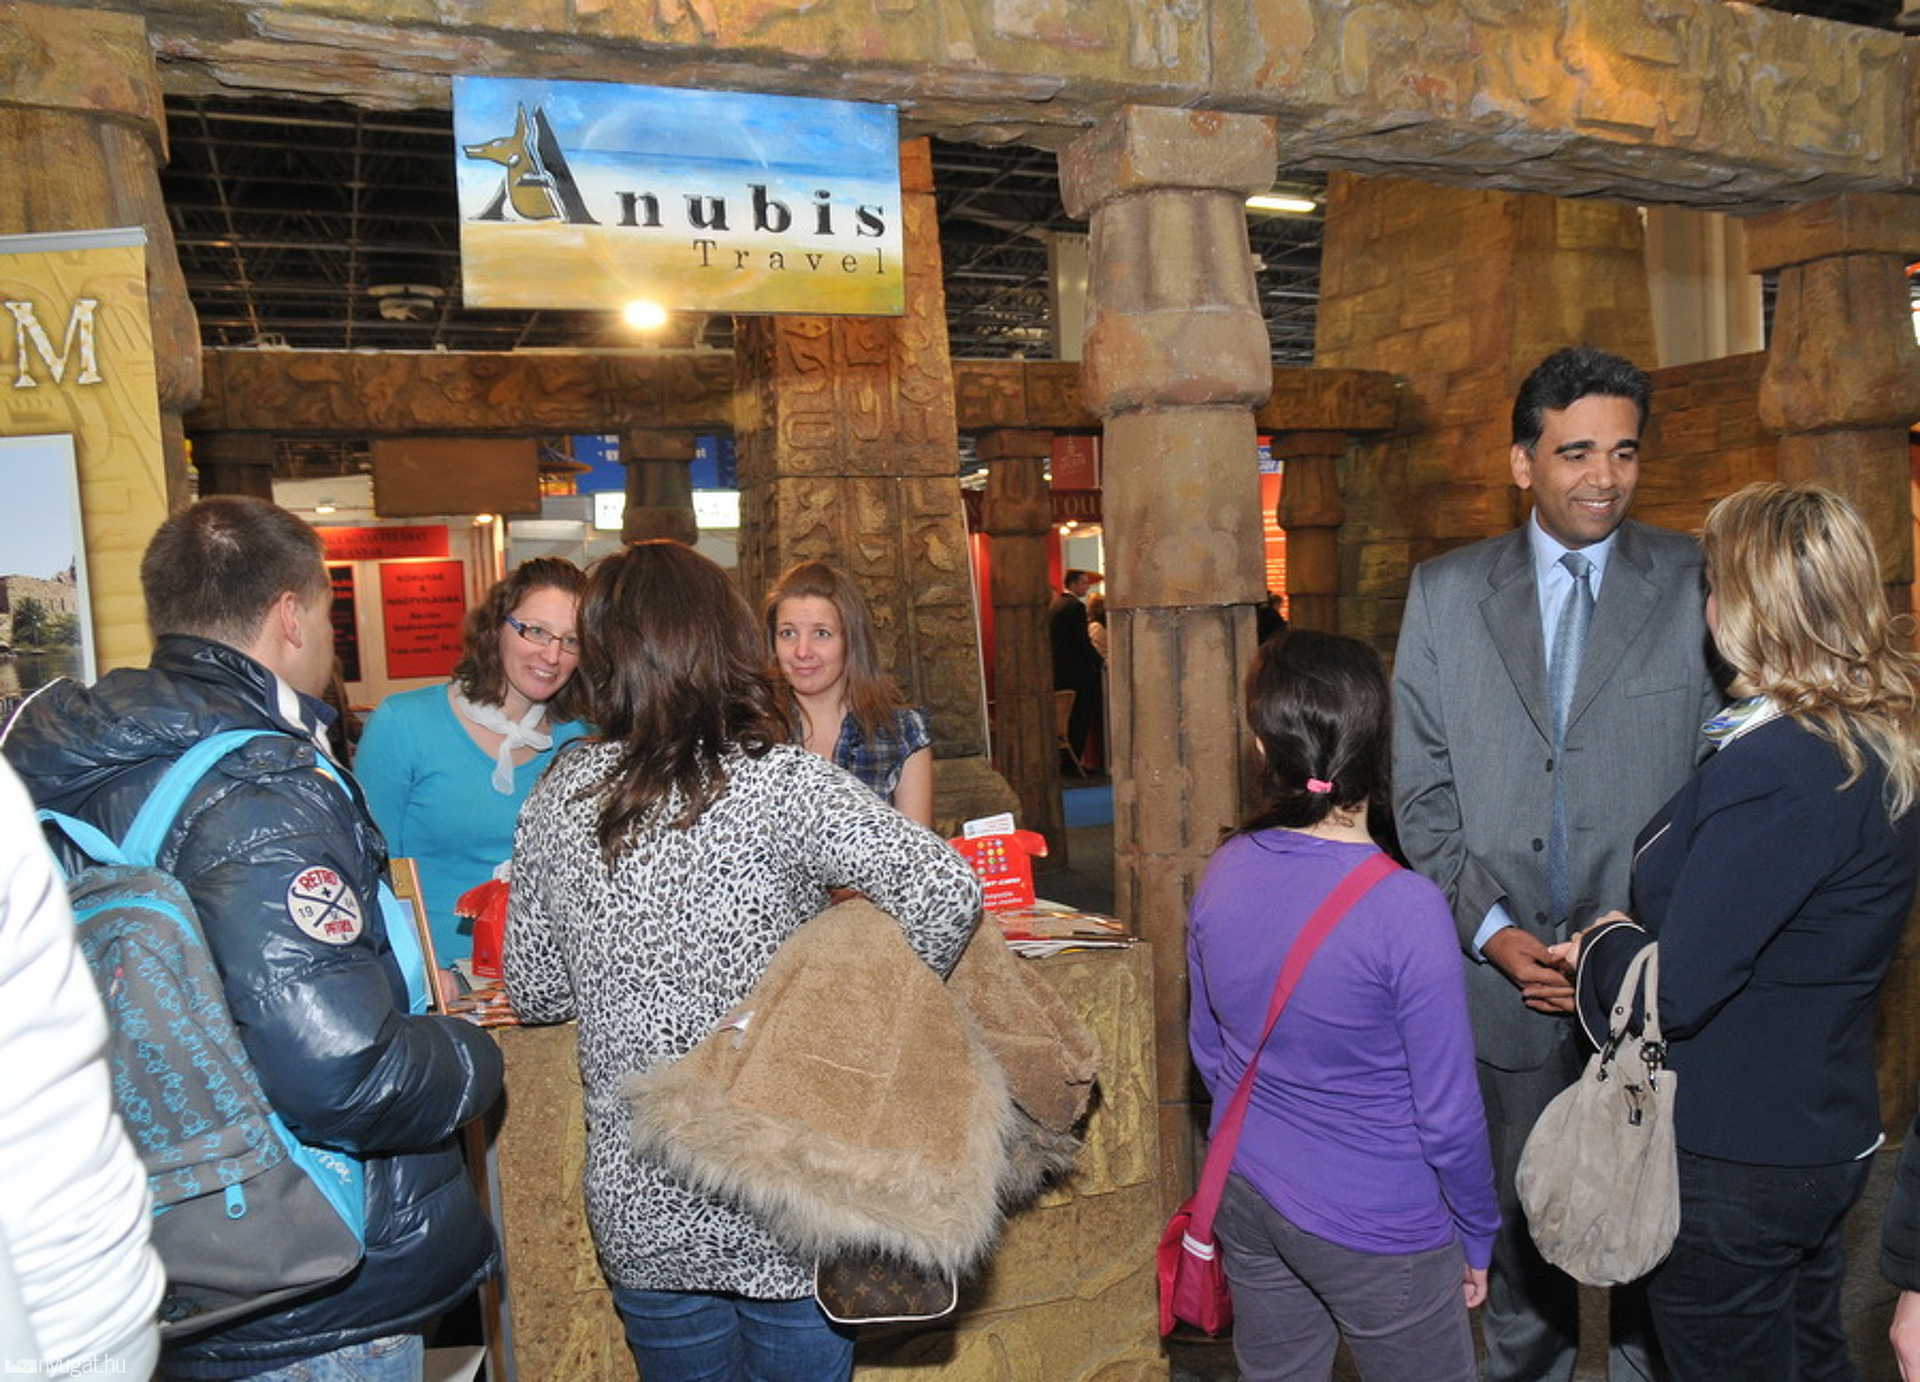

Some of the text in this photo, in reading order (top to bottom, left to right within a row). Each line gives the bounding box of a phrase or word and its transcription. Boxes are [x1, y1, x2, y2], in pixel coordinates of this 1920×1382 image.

[464, 103, 888, 238] Anubis
[692, 239, 886, 275] Travel
[5, 299, 103, 387] M
[298, 869, 338, 891] RETRO
